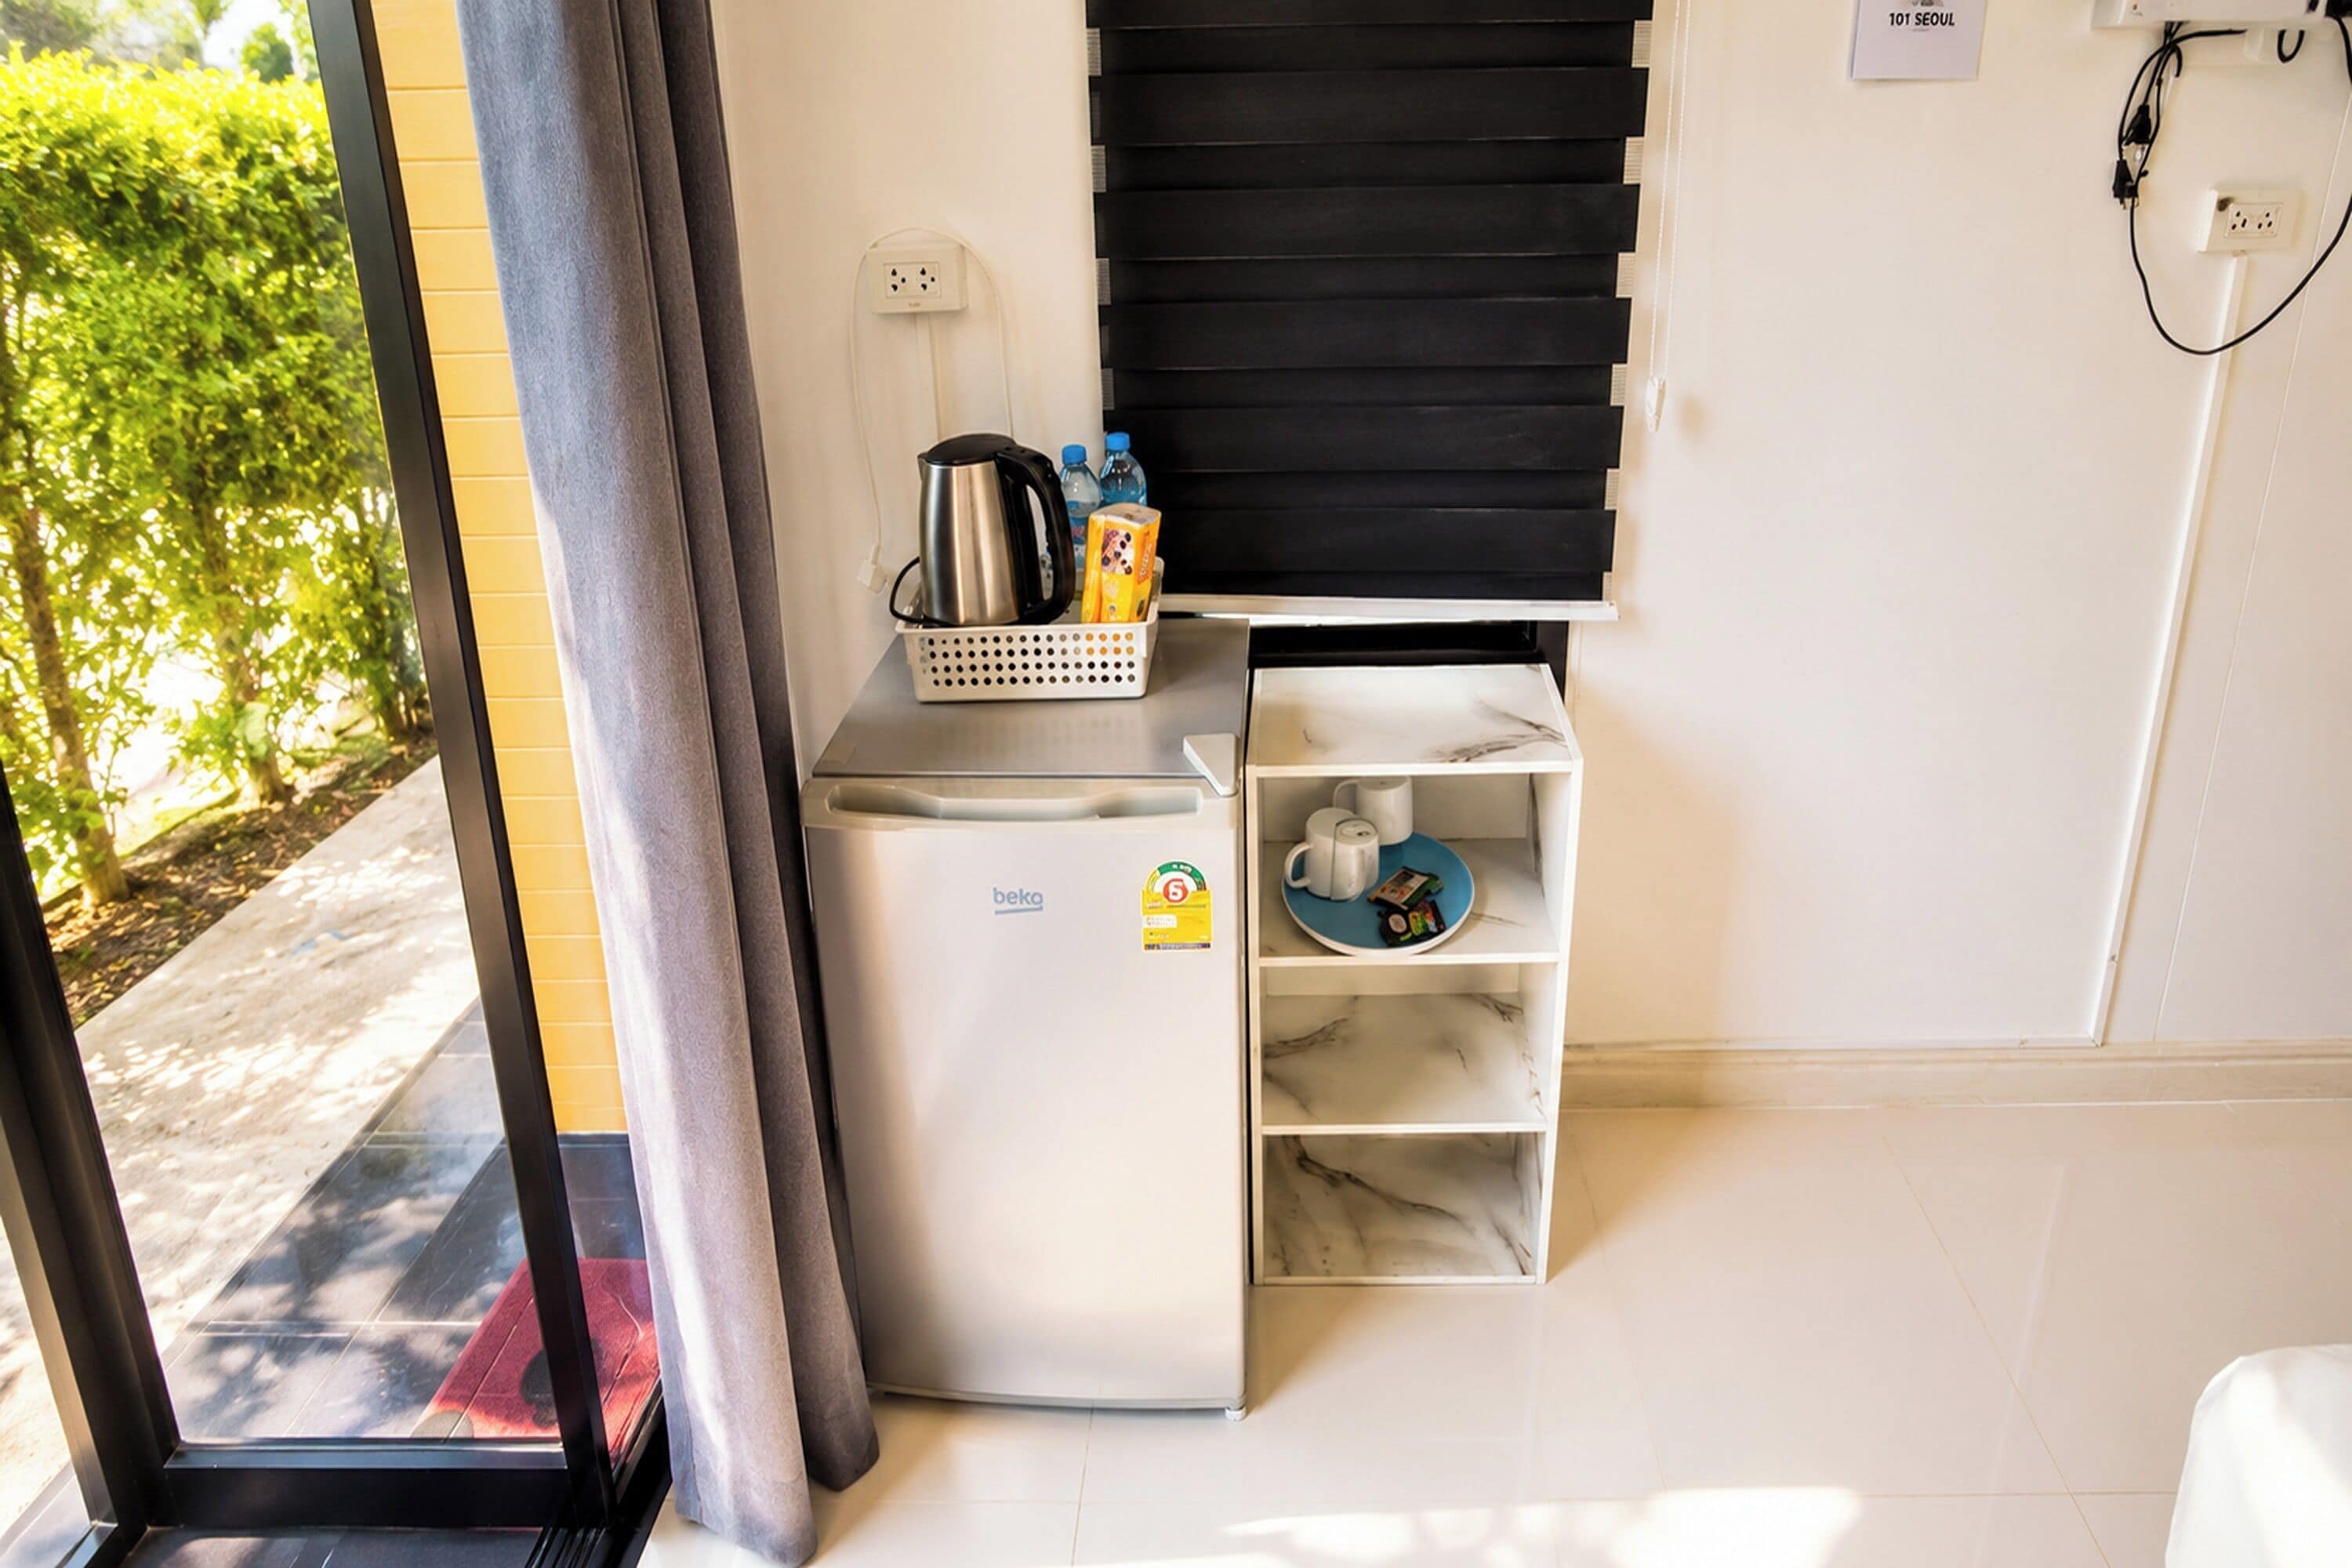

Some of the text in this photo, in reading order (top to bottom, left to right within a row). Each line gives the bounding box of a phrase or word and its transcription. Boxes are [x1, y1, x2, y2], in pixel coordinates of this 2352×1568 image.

[1889, 12, 1955, 26] 101 SEOUL
[993, 887, 1044, 906] beko
